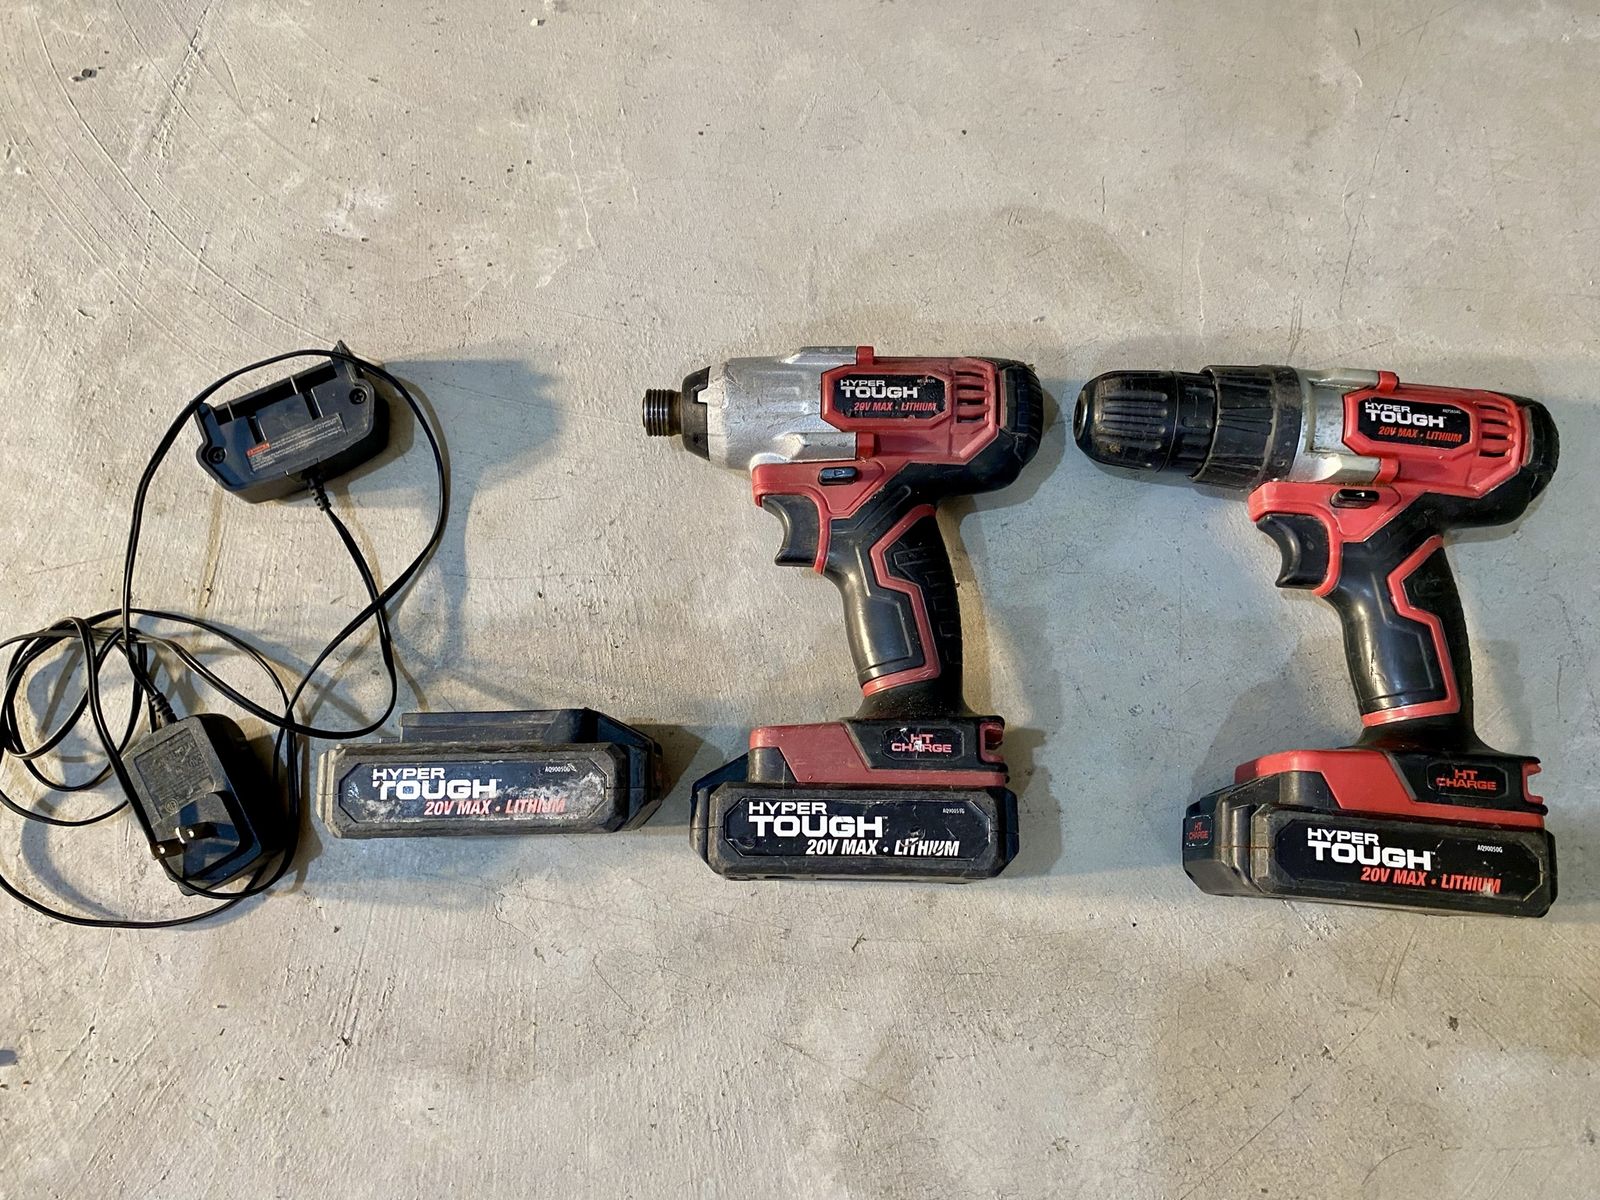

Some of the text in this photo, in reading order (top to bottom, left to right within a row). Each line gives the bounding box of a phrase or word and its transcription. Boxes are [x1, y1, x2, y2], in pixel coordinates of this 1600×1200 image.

[841, 386, 918, 398] TOUGH
[854, 402, 936, 411] 20V MAX LITHIUM
[1365, 402, 1410, 413] HYPER
[1365, 409, 1444, 428] TOUGH
[1378, 426, 1462, 442] 20V MAX LITHIUM
[910, 733, 933, 743] HT
[891, 742, 952, 753] CHARGE
[372, 767, 444, 780] HYPER
[1455, 769, 1478, 780] HT
[372, 779, 497, 800] TOUGH
[1436, 777, 1496, 790] CHARGE
[424, 799, 566, 816] 20V MAX LITHIUM
[749, 802, 827, 814] HYPER
[749, 815, 883, 838] TOUGH
[1194, 822, 1203, 831] HT
[1188, 831, 1209, 840] CHARGE
[1307, 828, 1379, 846] HYPER
[805, 838, 960, 856] 20V MAX LITHIUM
[1308, 840, 1432, 871] TOUGH
[1360, 867, 1501, 894] 20V MAX LITHIUM
